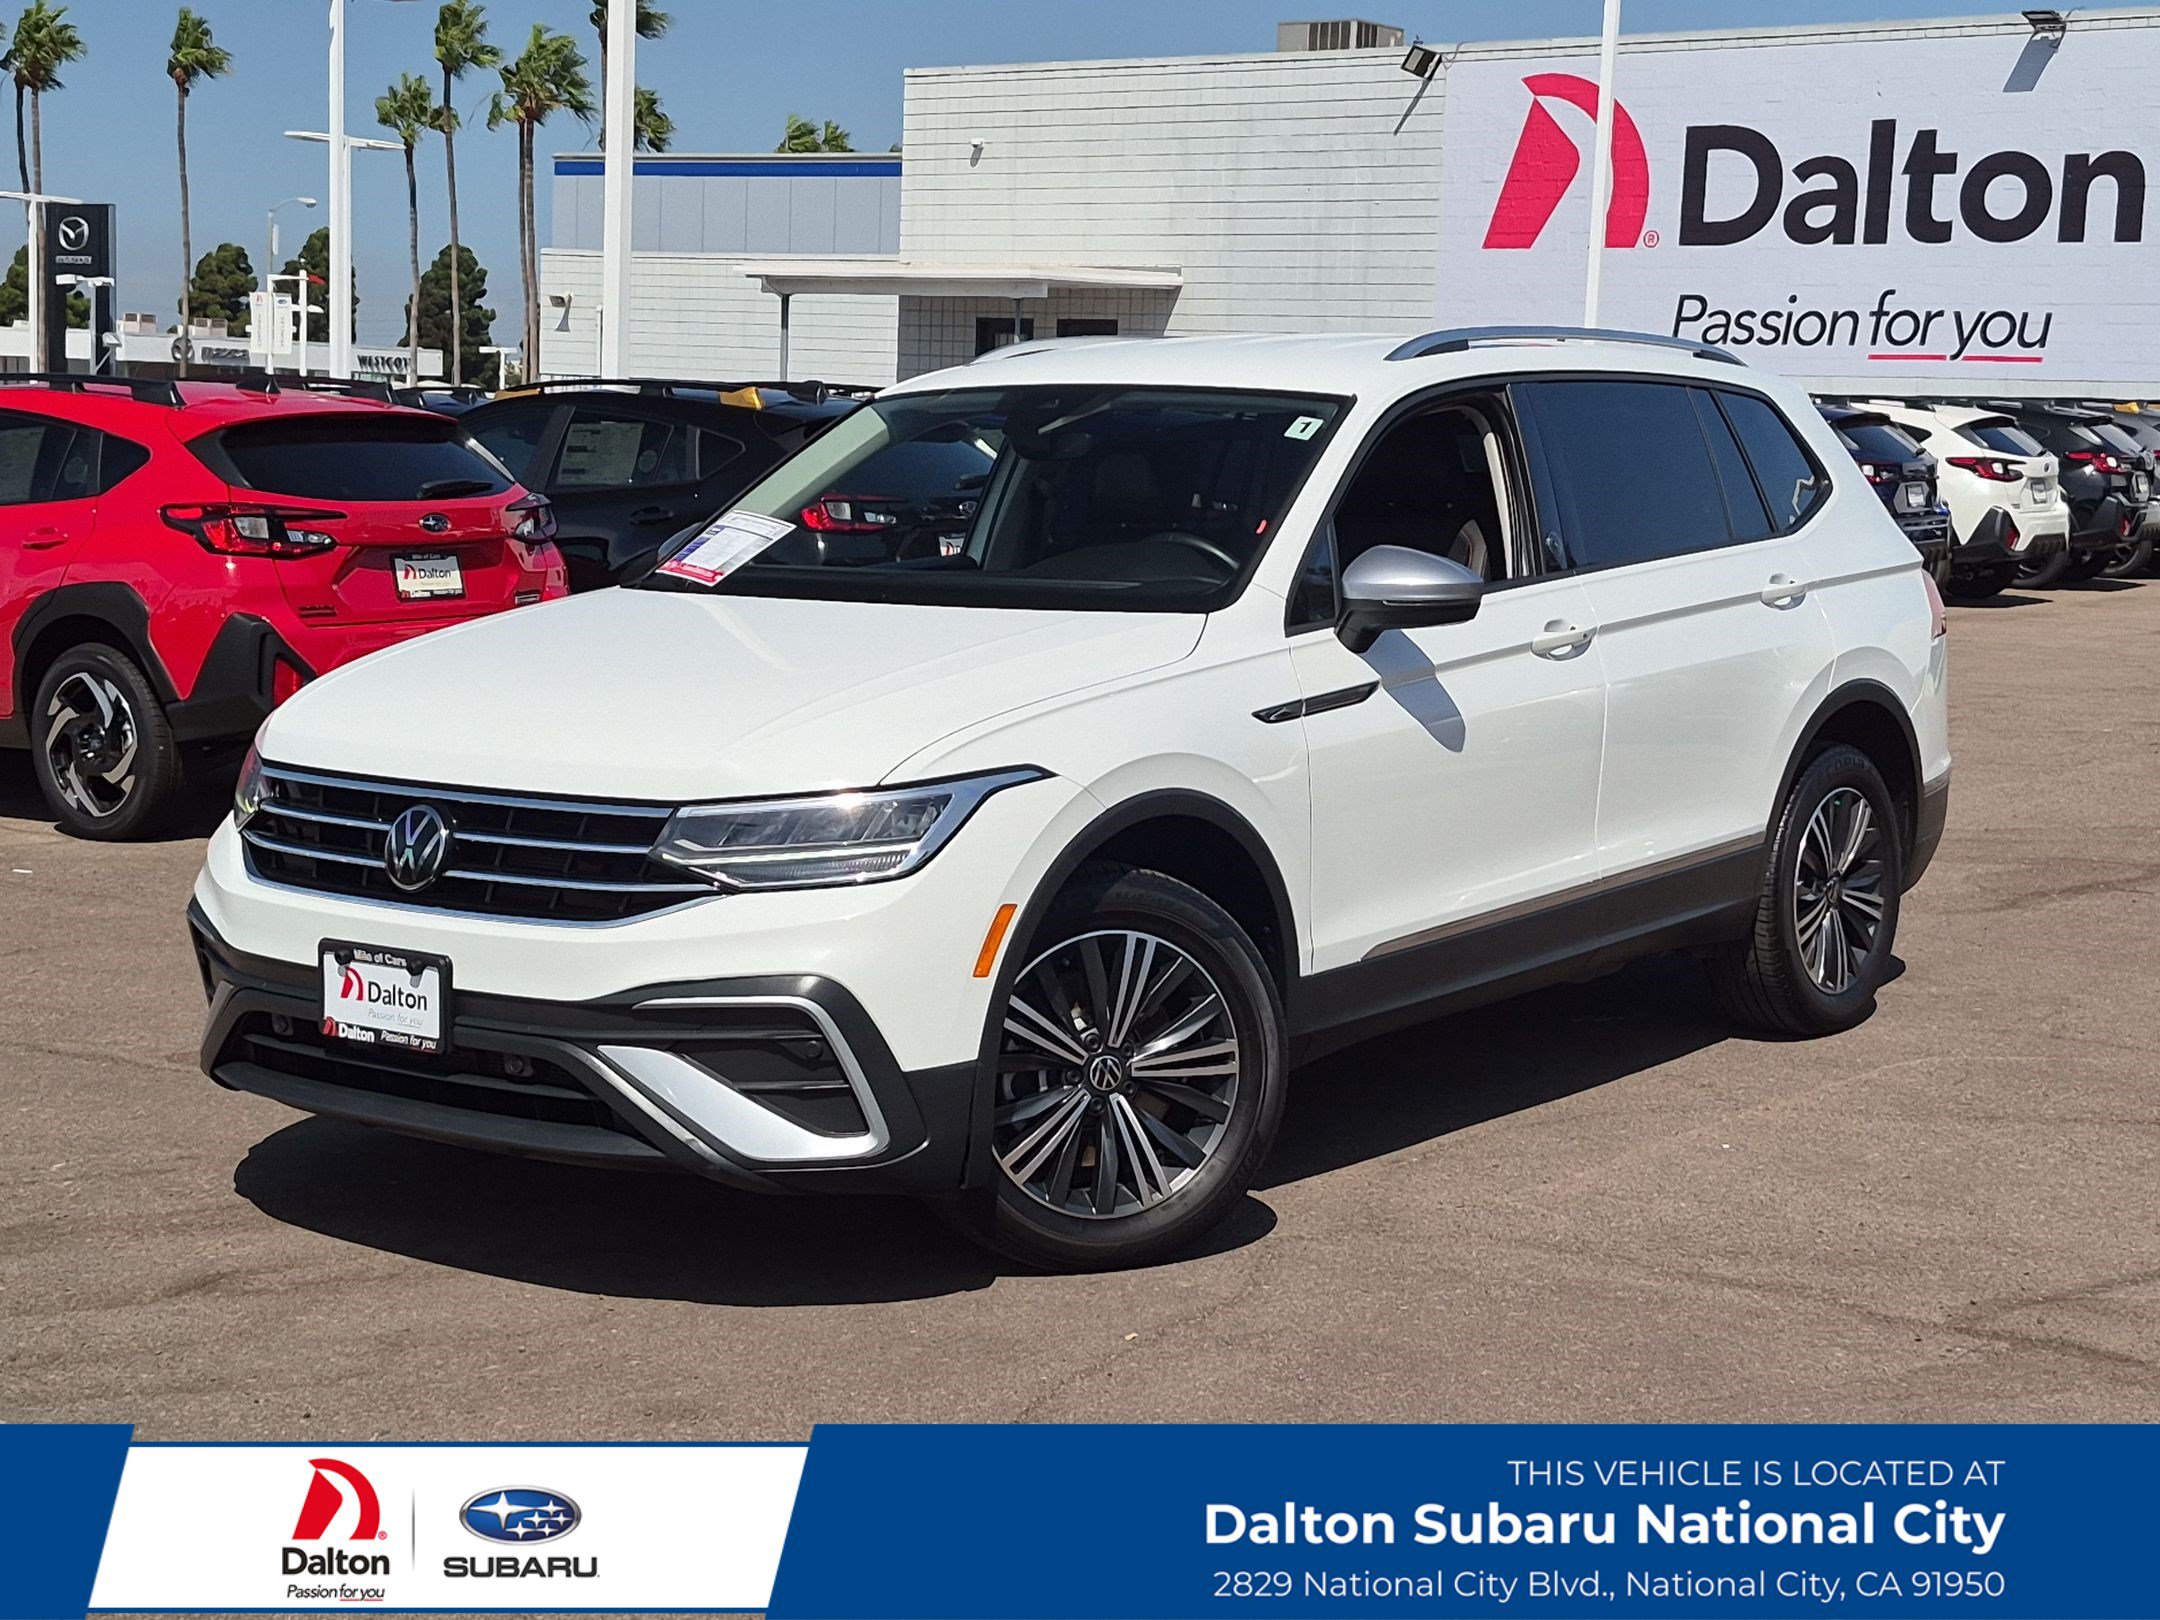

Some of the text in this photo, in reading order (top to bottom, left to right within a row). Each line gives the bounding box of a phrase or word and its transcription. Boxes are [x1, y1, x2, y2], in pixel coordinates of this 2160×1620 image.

[1678, 118, 2146, 246] Dalton
[1671, 289, 2053, 361] Passion for you
[1299, 421, 1313, 434] 1
[418, 568, 452, 579] Dalton
[368, 981, 427, 1011] Dalton
[338, 1023, 376, 1043] Dalton
[421, 1040, 437, 1050] you
